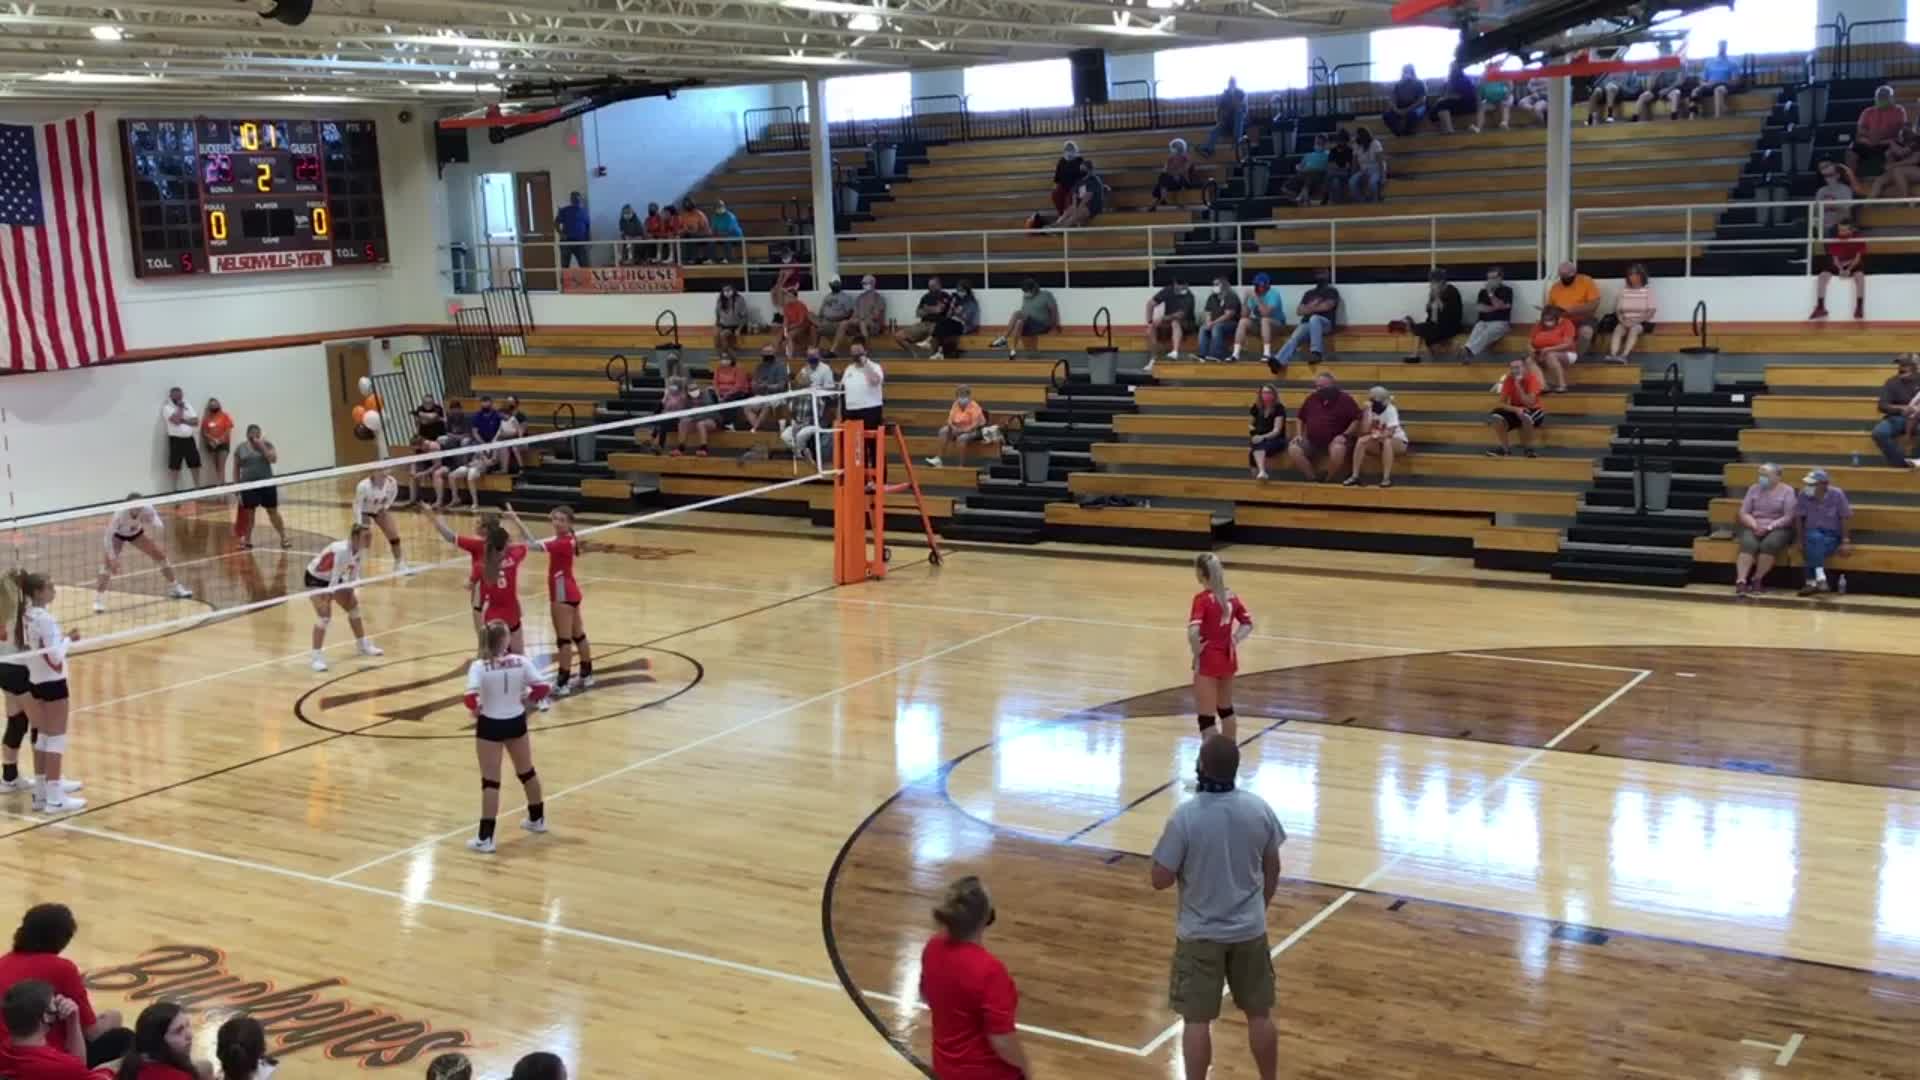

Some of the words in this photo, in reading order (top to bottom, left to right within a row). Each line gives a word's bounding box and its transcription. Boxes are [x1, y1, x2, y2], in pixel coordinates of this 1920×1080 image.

[291, 144, 317, 154] GUEST
[257, 164, 271, 192] 2
[210, 211, 226, 239] 0
[313, 208, 327, 235] 0
